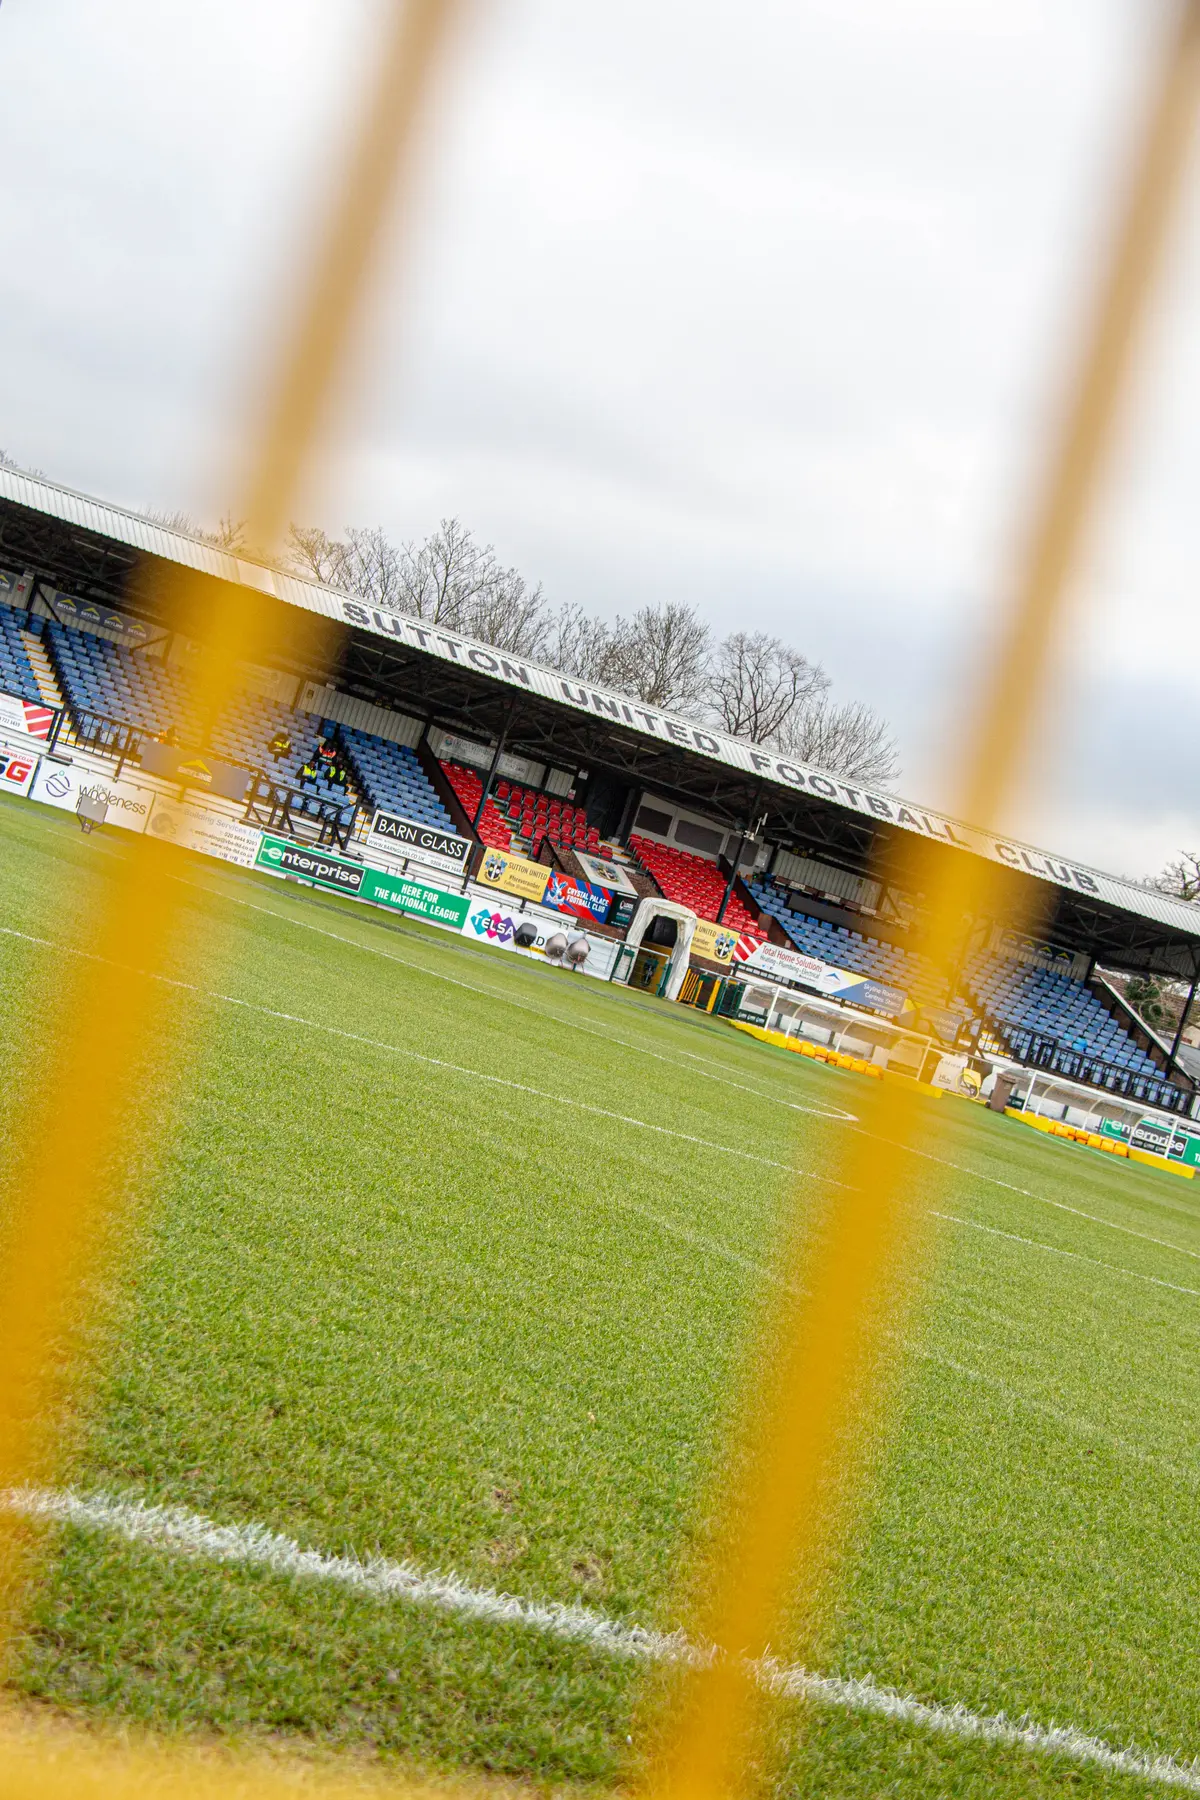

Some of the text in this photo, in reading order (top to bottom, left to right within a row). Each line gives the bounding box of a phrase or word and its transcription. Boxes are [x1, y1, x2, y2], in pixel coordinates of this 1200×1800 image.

[342, 602, 1099, 893] SUTTON UNITED FOOTBALL CLUB
[216, 819, 248, 836] Services
[378, 818, 418, 842] BARN
[420, 832, 464, 858] GLASS
[262, 847, 361, 885] enterprise
[508, 862, 548, 881] SUTTON UNITED
[373, 886, 460, 922] THE NATIONAL LEAGUE
[401, 883, 439, 904] HERE FOR
[566, 887, 590, 901] CRYSTAL
[589, 895, 610, 907] PALACE
[566, 895, 591, 909] FOOTBALL
[592, 903, 606, 914] CLUB
[474, 915, 514, 937] TELSA
[763, 945, 823, 973] Total Home Solutions
